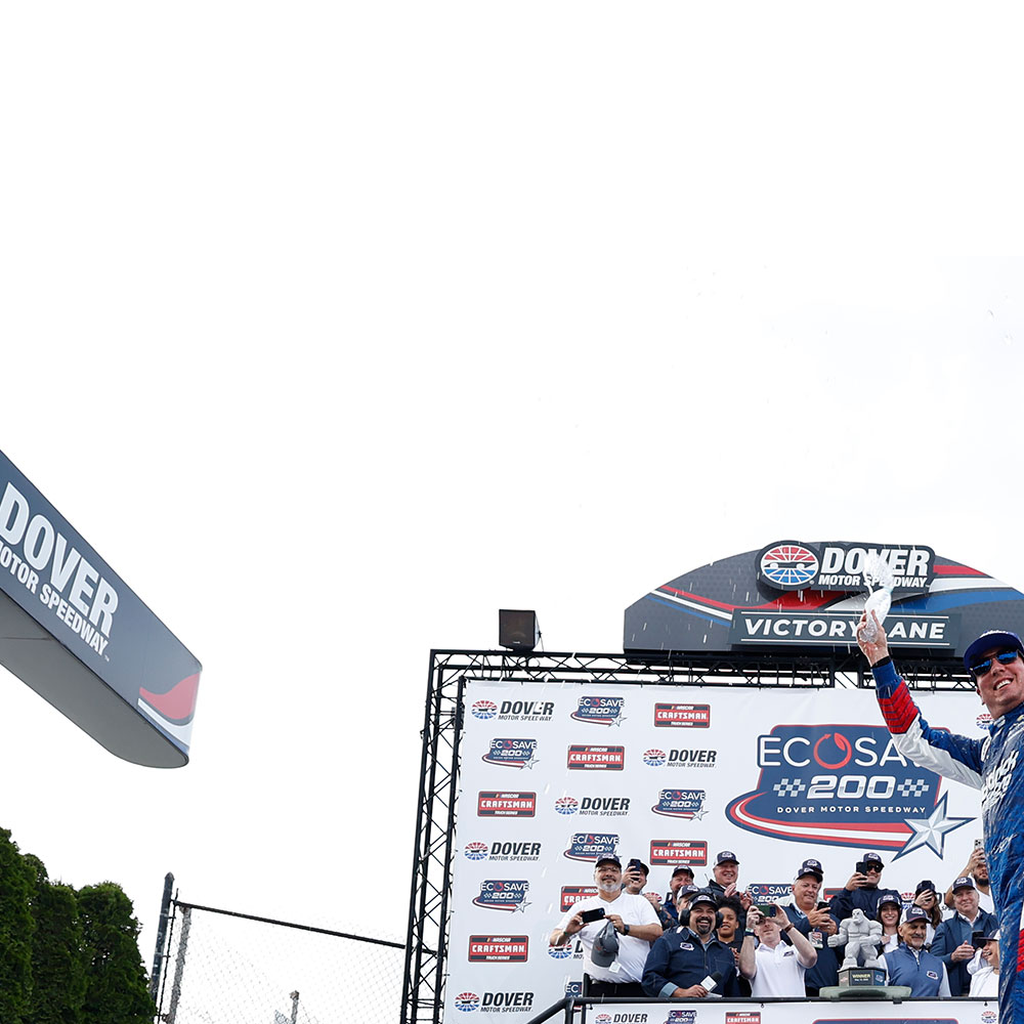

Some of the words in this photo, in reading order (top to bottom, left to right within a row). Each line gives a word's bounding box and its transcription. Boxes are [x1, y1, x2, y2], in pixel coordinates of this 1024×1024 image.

[0, 481, 119, 638] DOVER
[818, 575, 860, 586] MOTOR
[39, 583, 110, 657] SPEEDWAY
[745, 618, 859, 637] VICTORY
[886, 621, 945, 639] ANE
[500, 701, 554, 715] DOVER
[578, 697, 625, 708] ECOSAVE
[657, 712, 708, 720] CRAFTSMAN
[490, 740, 537, 750] ECOSAVE
[668, 750, 717, 763] DOVER
[759, 736, 922, 767] ECOSA
[570, 753, 621, 762] CRAFTSMAN
[806, 774, 897, 799] 200
[659, 791, 706, 801] ECOSAVE
[480, 800, 533, 809] CRAFTSMAN
[581, 797, 631, 811] DOVER
[571, 835, 619, 845] ECOSAVE
[490, 843, 542, 856] DOVER
[653, 849, 704, 858] CRAFTSMAN
[480, 882, 529, 892] ECOSAVE
[472, 944, 525, 953] CRAFTSMAN
[482, 992, 534, 1007] DOVER
[613, 1014, 648, 1023] DOVER
